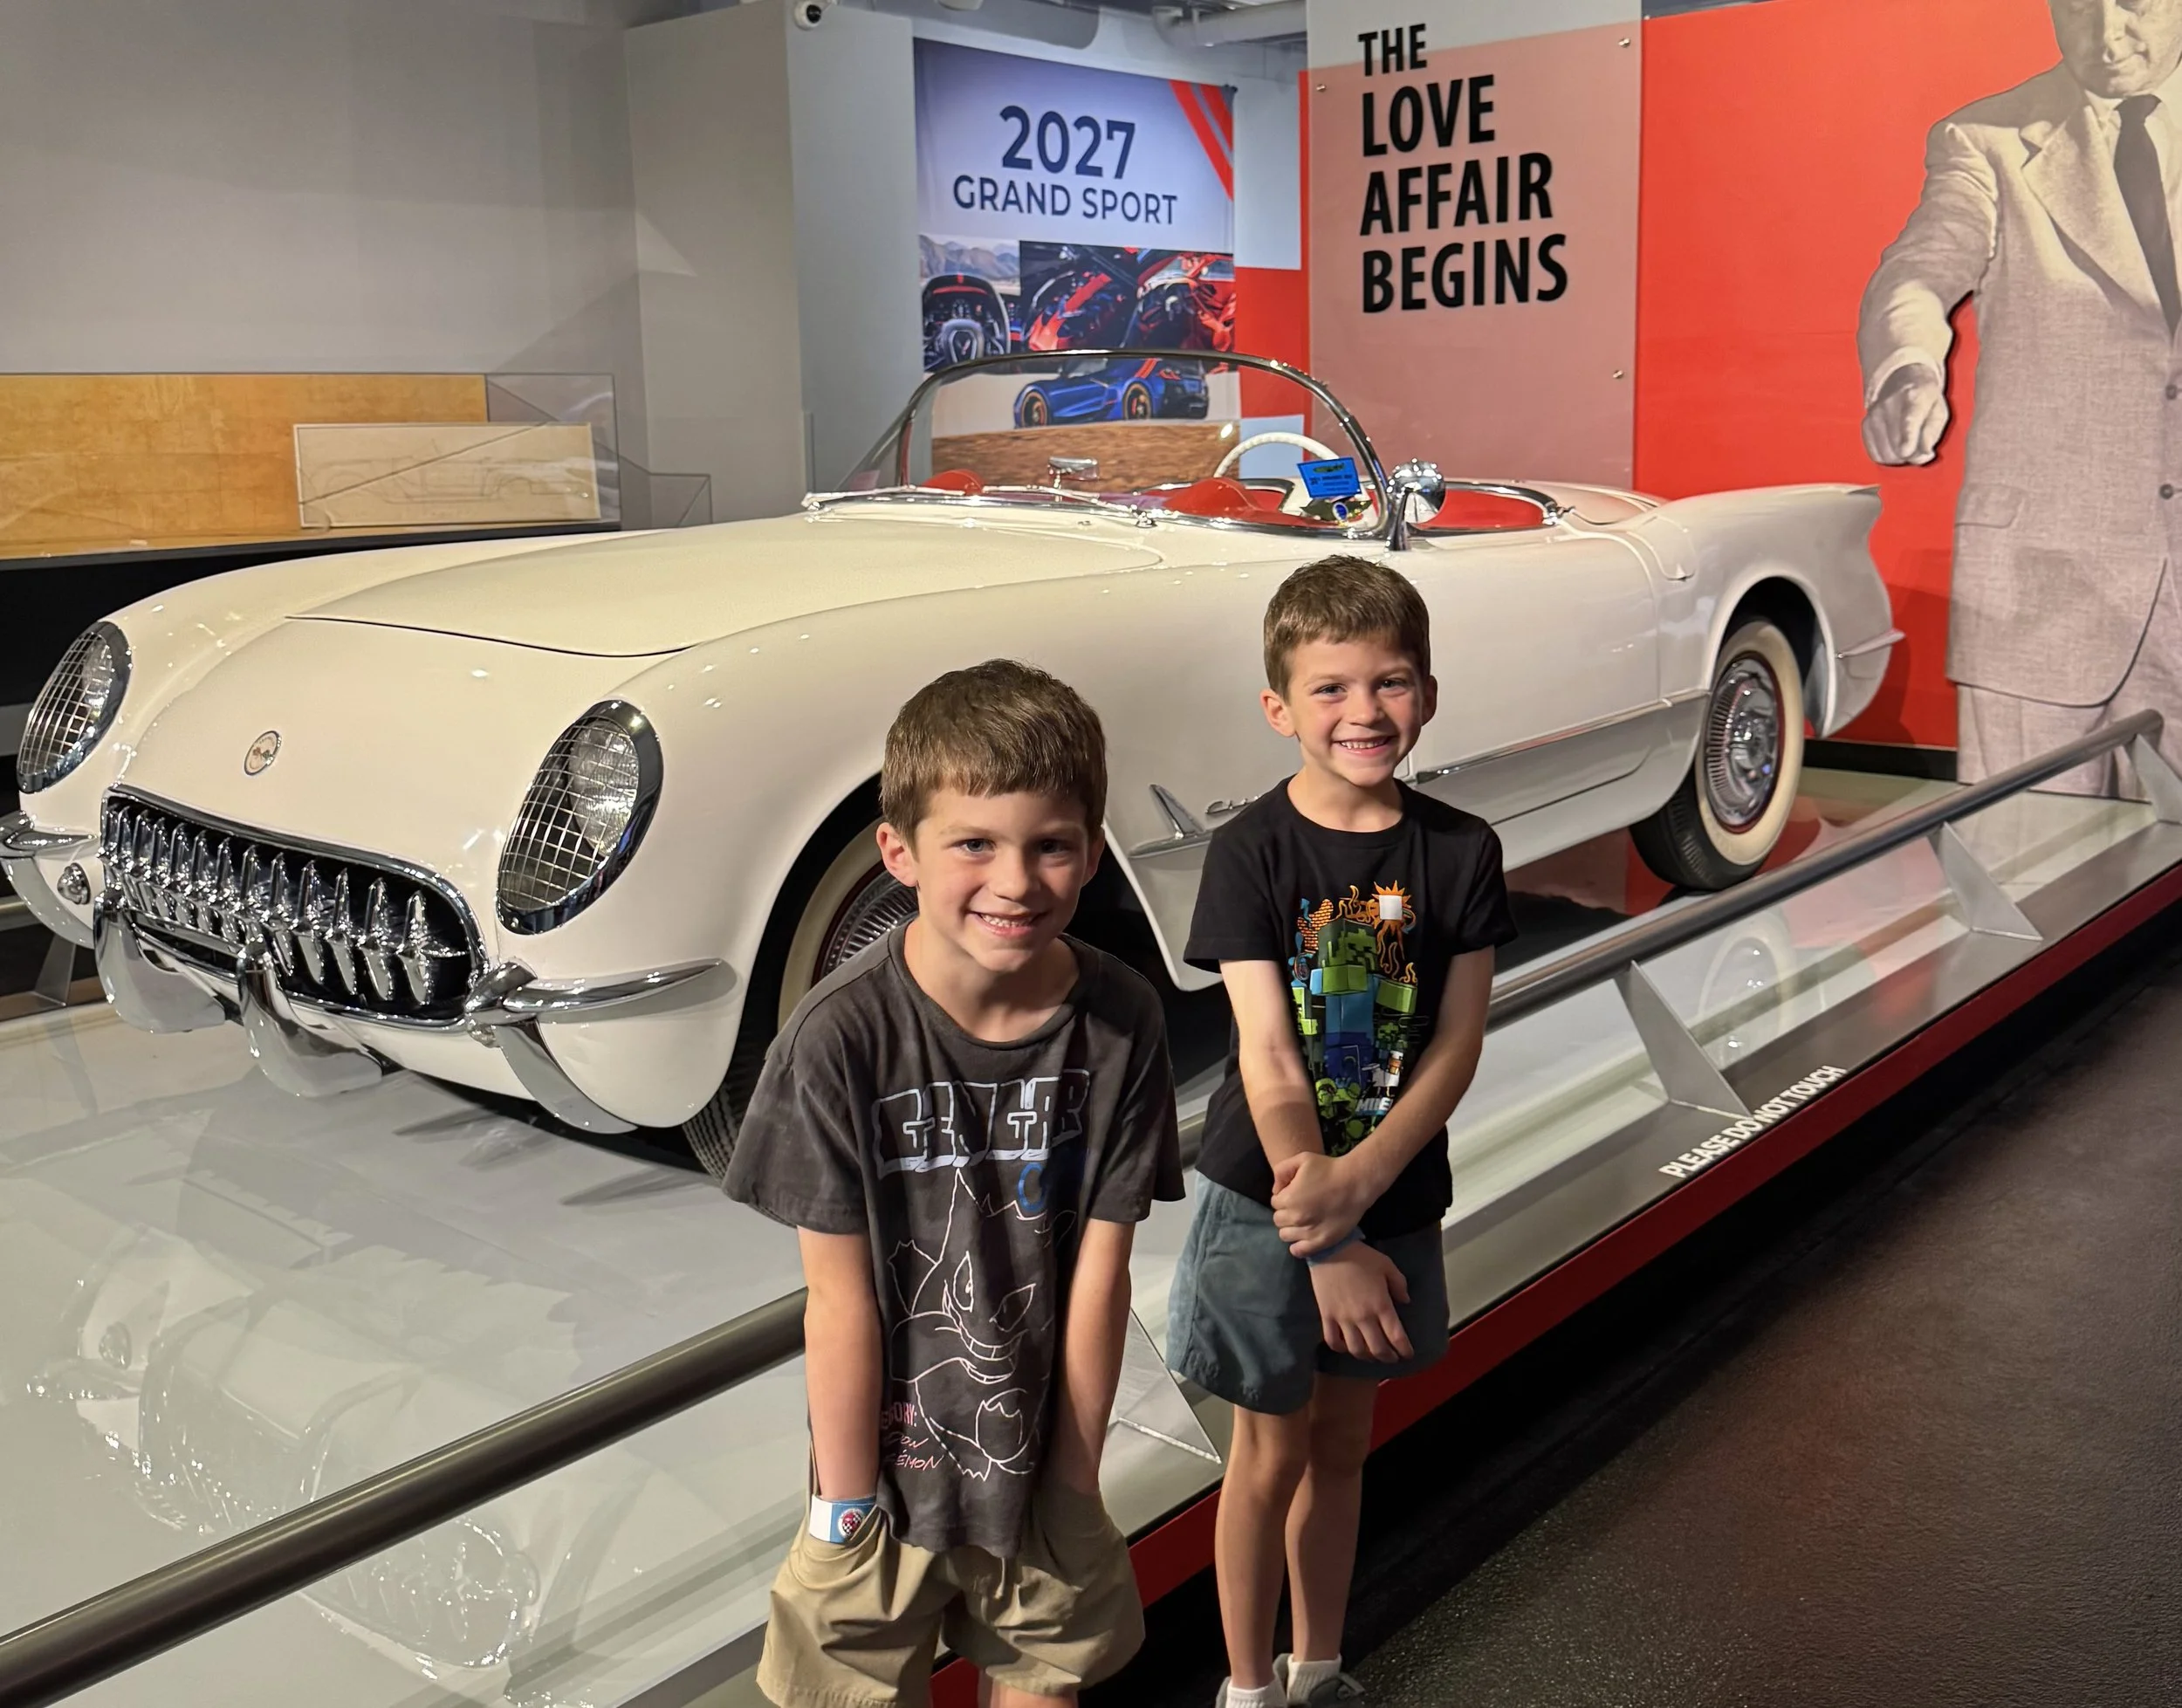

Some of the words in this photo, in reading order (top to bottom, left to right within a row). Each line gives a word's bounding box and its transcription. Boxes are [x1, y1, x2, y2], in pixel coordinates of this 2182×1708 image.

[1358, 24, 1427, 76] THE
[999, 106, 1135, 179] 2027
[1362, 74, 1495, 157] LOVE
[953, 175, 1071, 216] GRAND
[1082, 188, 1177, 224] SPORT
[1360, 152, 1553, 236] AFFAIR
[1362, 233, 1568, 313] BEGINS
[1658, 1134, 1741, 1178] PLEASE
[1721, 1118, 1764, 1142] DO
[1753, 1097, 1789, 1124] NOT
[1781, 1065, 1848, 1108] TOUCH
